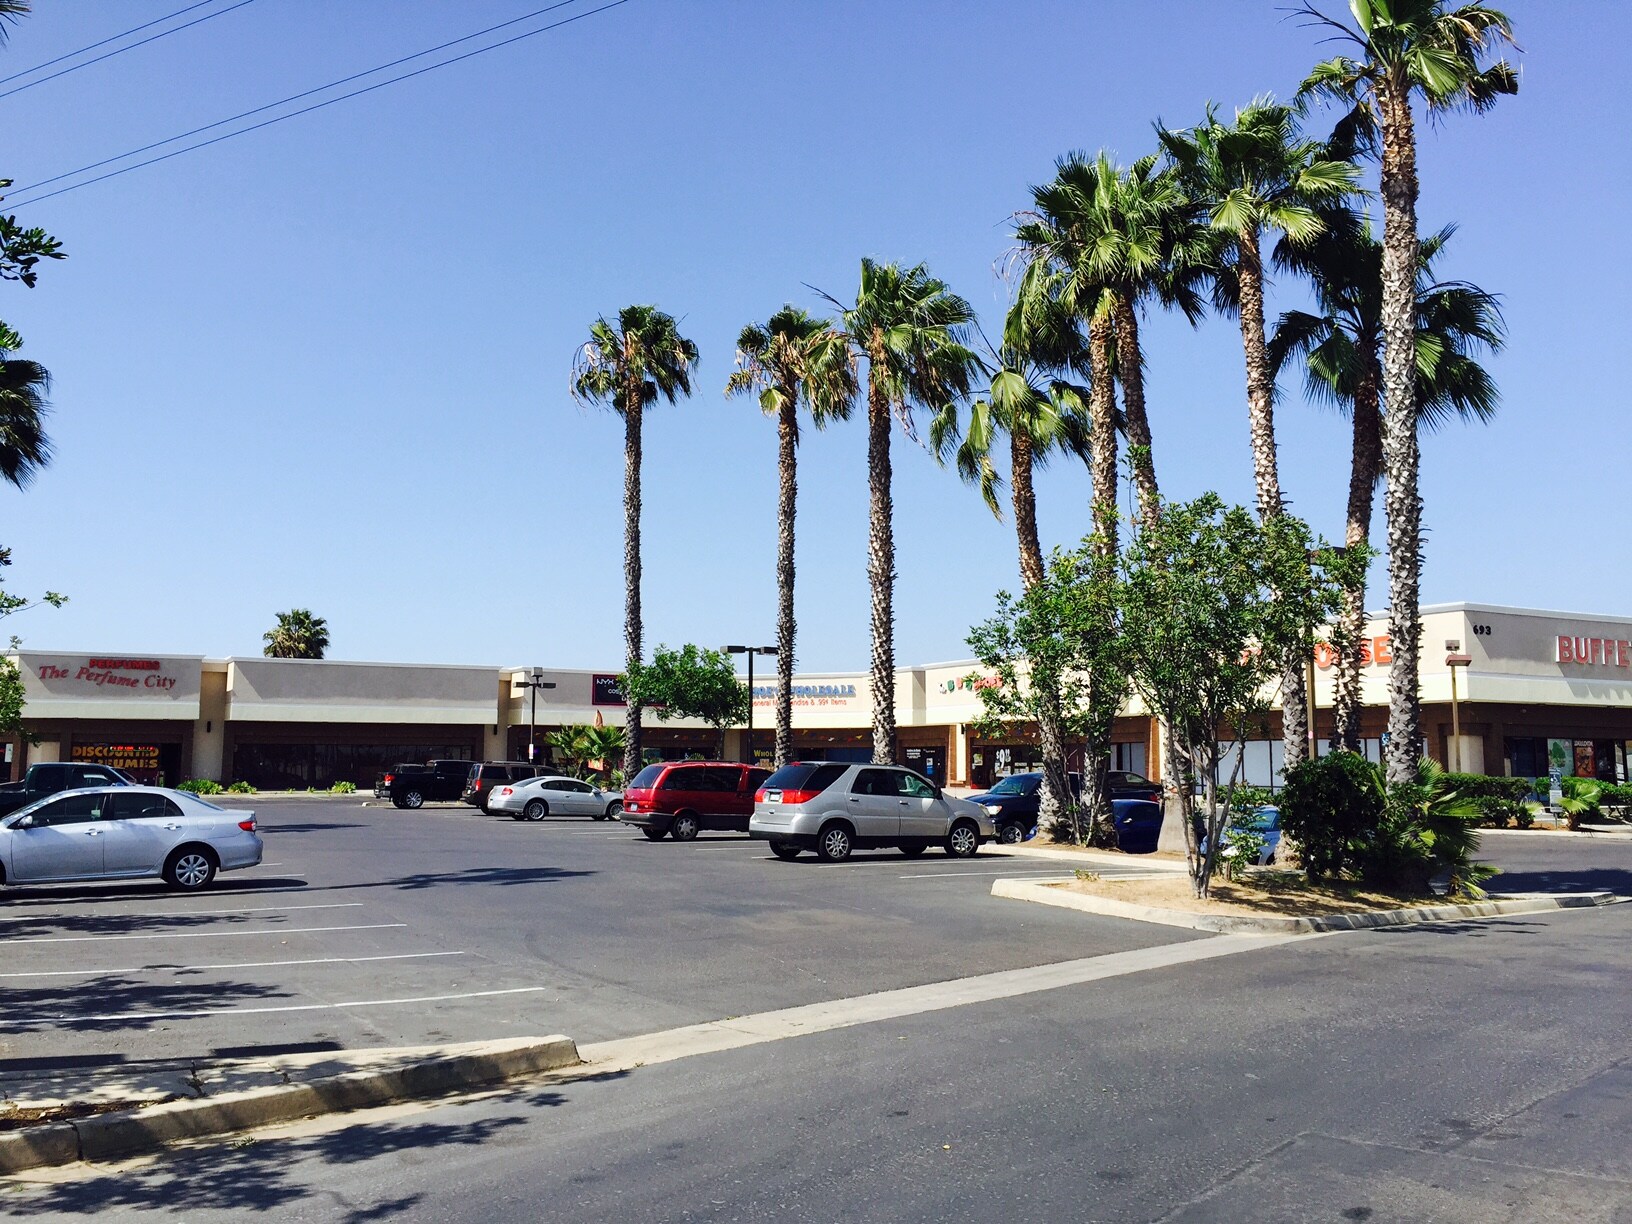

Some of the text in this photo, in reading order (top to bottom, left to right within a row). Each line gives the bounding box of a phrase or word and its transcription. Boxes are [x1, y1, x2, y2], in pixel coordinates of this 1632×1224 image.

[1472, 624, 1492, 636] 693
[1555, 635, 1632, 667] BUFFE
[88, 659, 160, 670] PERFUMES
[38, 665, 176, 691] The Perfume City
